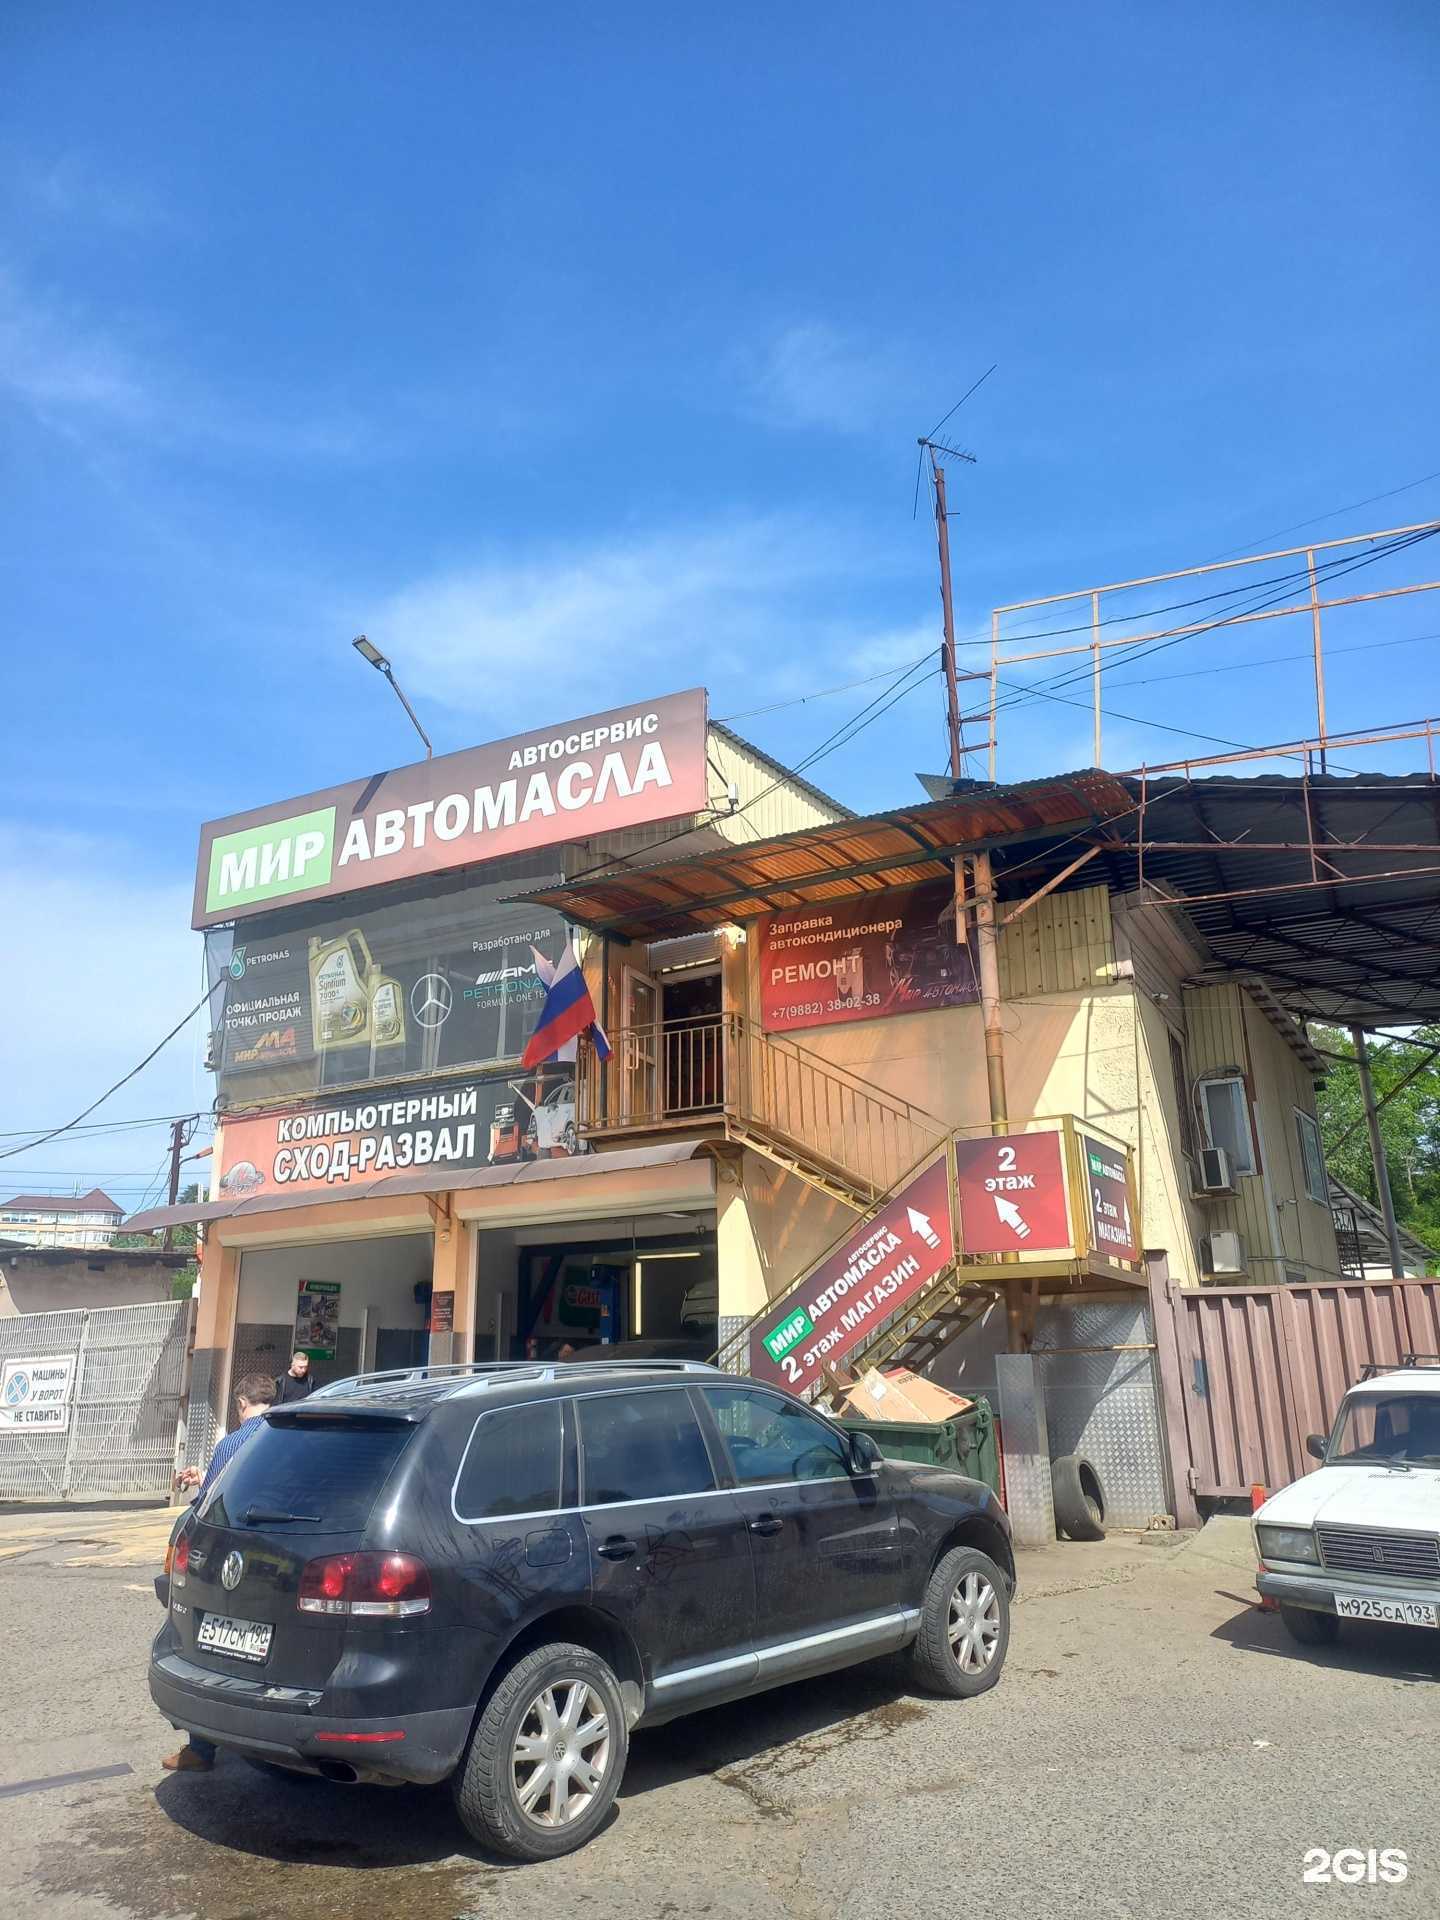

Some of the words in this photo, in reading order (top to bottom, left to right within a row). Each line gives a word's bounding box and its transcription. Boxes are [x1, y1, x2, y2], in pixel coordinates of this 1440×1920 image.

[508, 713, 659, 770] АВТОСЕРВИС
[218, 830, 326, 897] МИР
[338, 741, 673, 866] АВТОМАСЛА
[769, 915, 833, 936] Заправка
[769, 918, 903, 950] автокондиционера
[473, 932, 532, 952] Разработано
[534, 928, 551, 940] для
[246, 949, 290, 966] PETRONAS
[771, 954, 860, 985] РЕМОНТ
[463, 977, 544, 1000] PETRONA
[477, 998, 514, 1009] FORMULA
[516, 991, 534, 1002] ONE
[226, 992, 300, 1015] ОФИЦИАЛЬНАЯ
[225, 1016, 258, 1029] ТОЧКА
[259, 1006, 301, 1022] ПРОДАЖ
[277, 1087, 477, 1143] КОМПЬЮТЕРНЫЙ
[272, 1124, 475, 1184] СХОД-РАЗВАЛ
[997, 1146, 1017, 1172] 2
[984, 1174, 1036, 1192] этаж
[1094, 1188, 1103, 1213] 2
[847, 1226, 888, 1264] АВТОСЕРВИС
[1098, 1221, 1127, 1246] МАГАЗИН
[769, 1315, 806, 1355] МИР
[807, 1232, 902, 1322] АВТОМАСЛА
[781, 1354, 804, 1384] 2
[803, 1326, 845, 1367] этаж
[840, 1254, 920, 1332] МАГАЗИН
[32, 1368, 67, 1381] МАШИНЫ
[31, 1391, 38, 1401] У
[38, 1389, 64, 1401] ВОРОТ
[14, 1411, 23, 1422] НЕ
[26, 1409, 61, 1422] СТАВИТЬ
